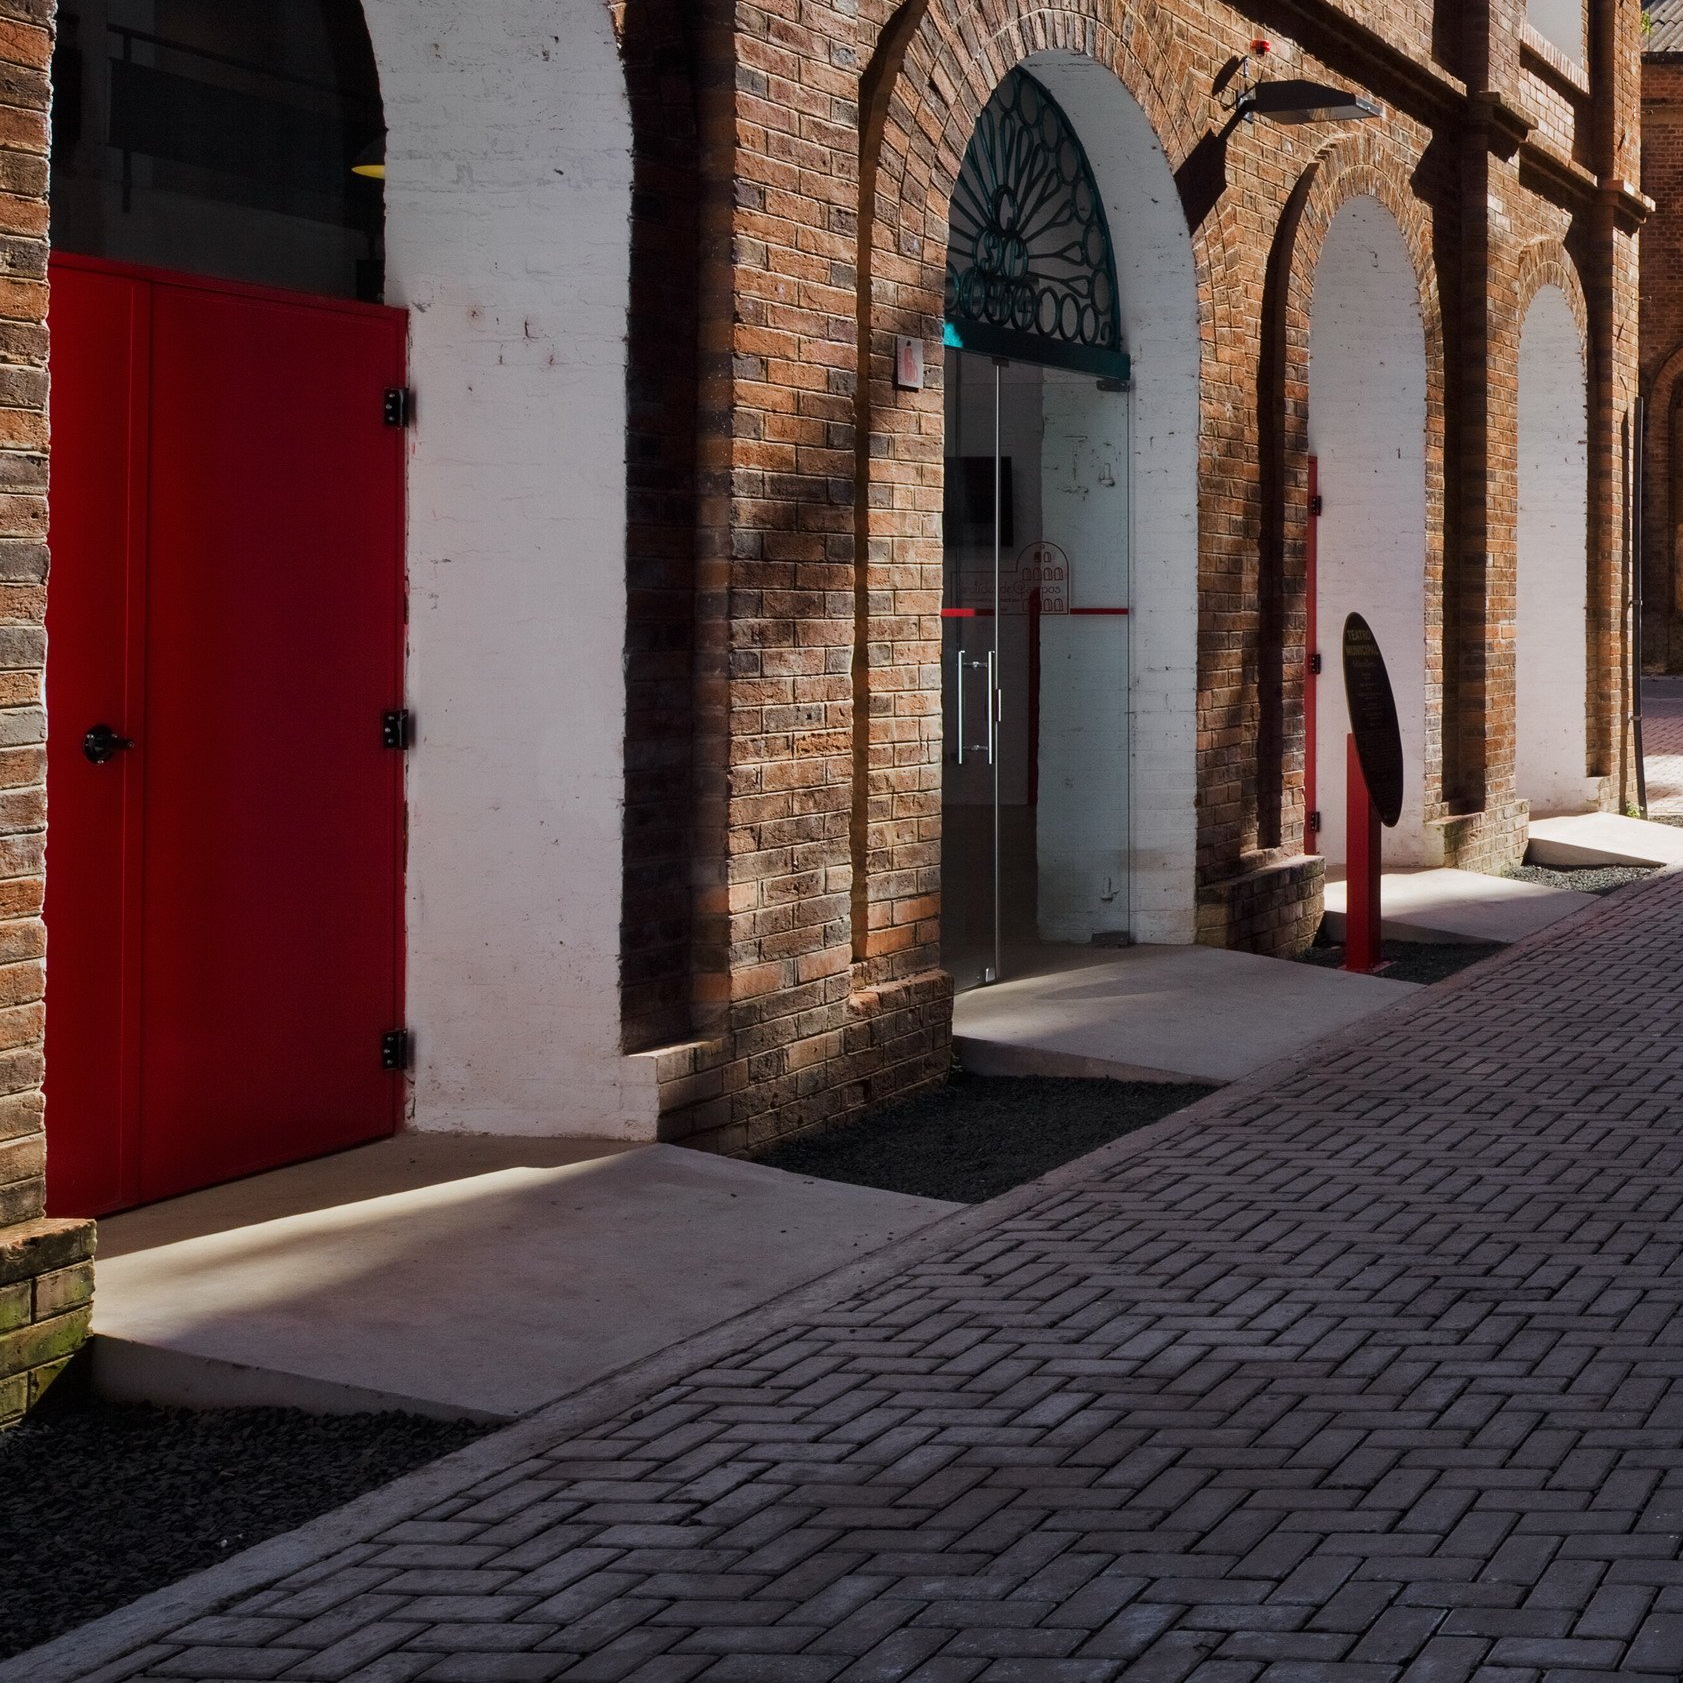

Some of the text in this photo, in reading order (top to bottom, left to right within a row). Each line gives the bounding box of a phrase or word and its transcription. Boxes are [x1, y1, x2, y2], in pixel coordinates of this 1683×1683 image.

[1013, 580, 1062, 600] Capos
[1346, 629, 1371, 641] TEATRO
[1345, 644, 1379, 656] MUNICIPAL
